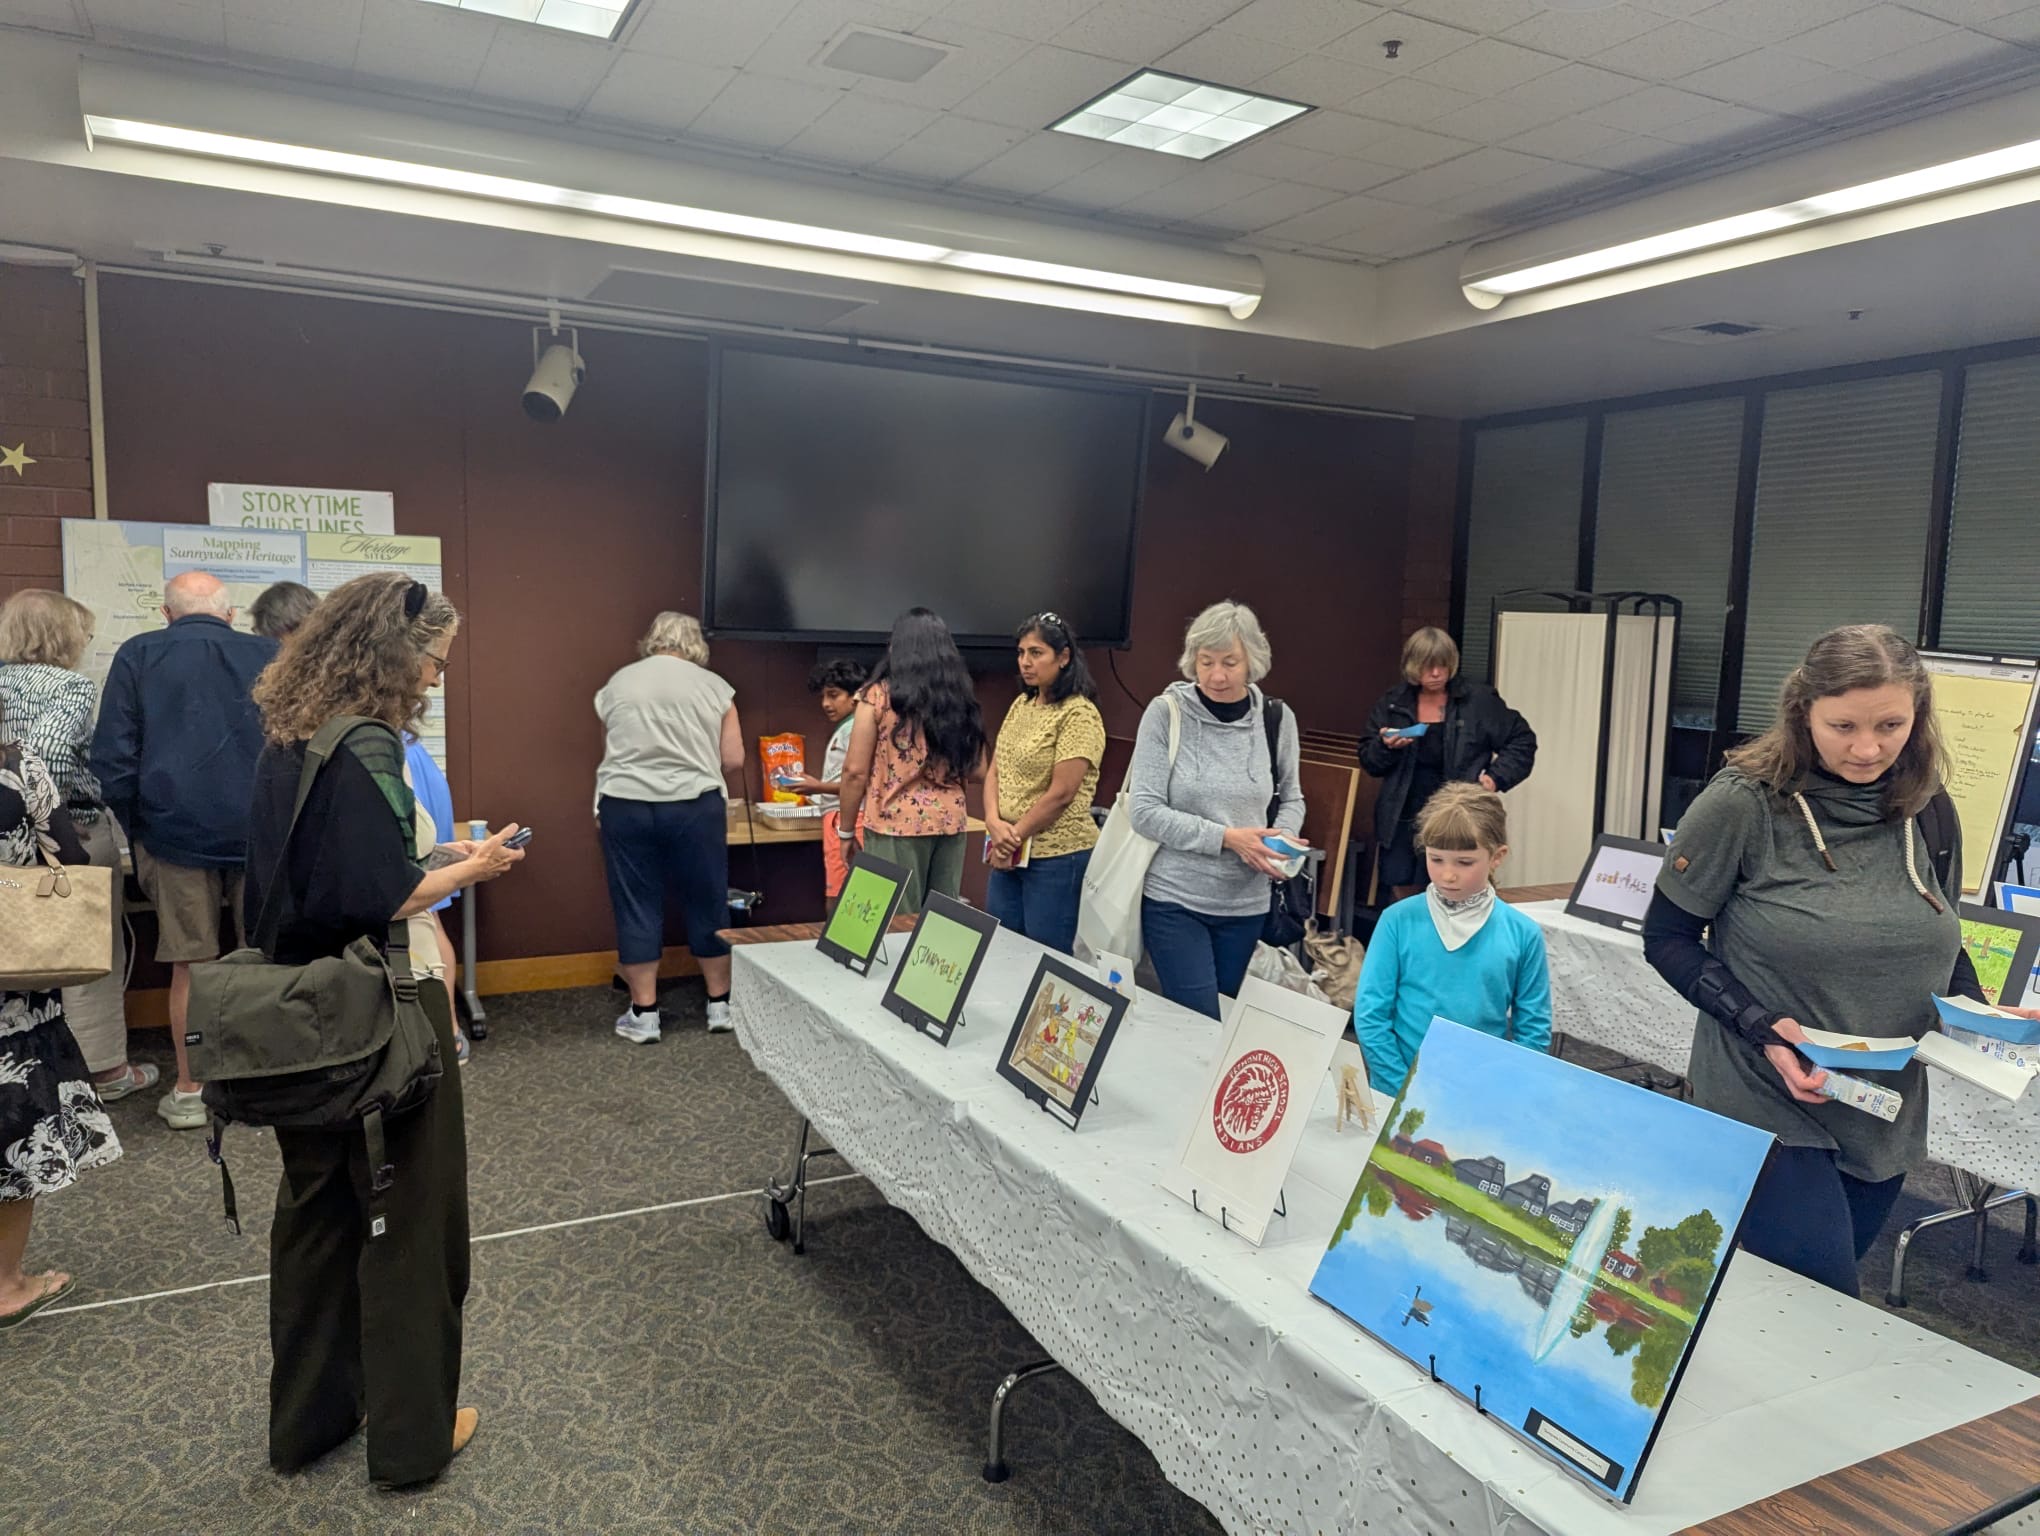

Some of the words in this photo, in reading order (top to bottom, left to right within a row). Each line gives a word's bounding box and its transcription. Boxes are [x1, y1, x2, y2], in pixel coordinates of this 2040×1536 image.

[241, 490, 364, 518] STORYTIME
[202, 537, 262, 551] Mapping
[340, 534, 412, 559] Heritage
[169, 546, 243, 561] Sunnyvale's
[245, 549, 297, 565] Heritage
[1263, 1054, 1281, 1074] HIGH
[1214, 1114, 1264, 1151] INDIANS
